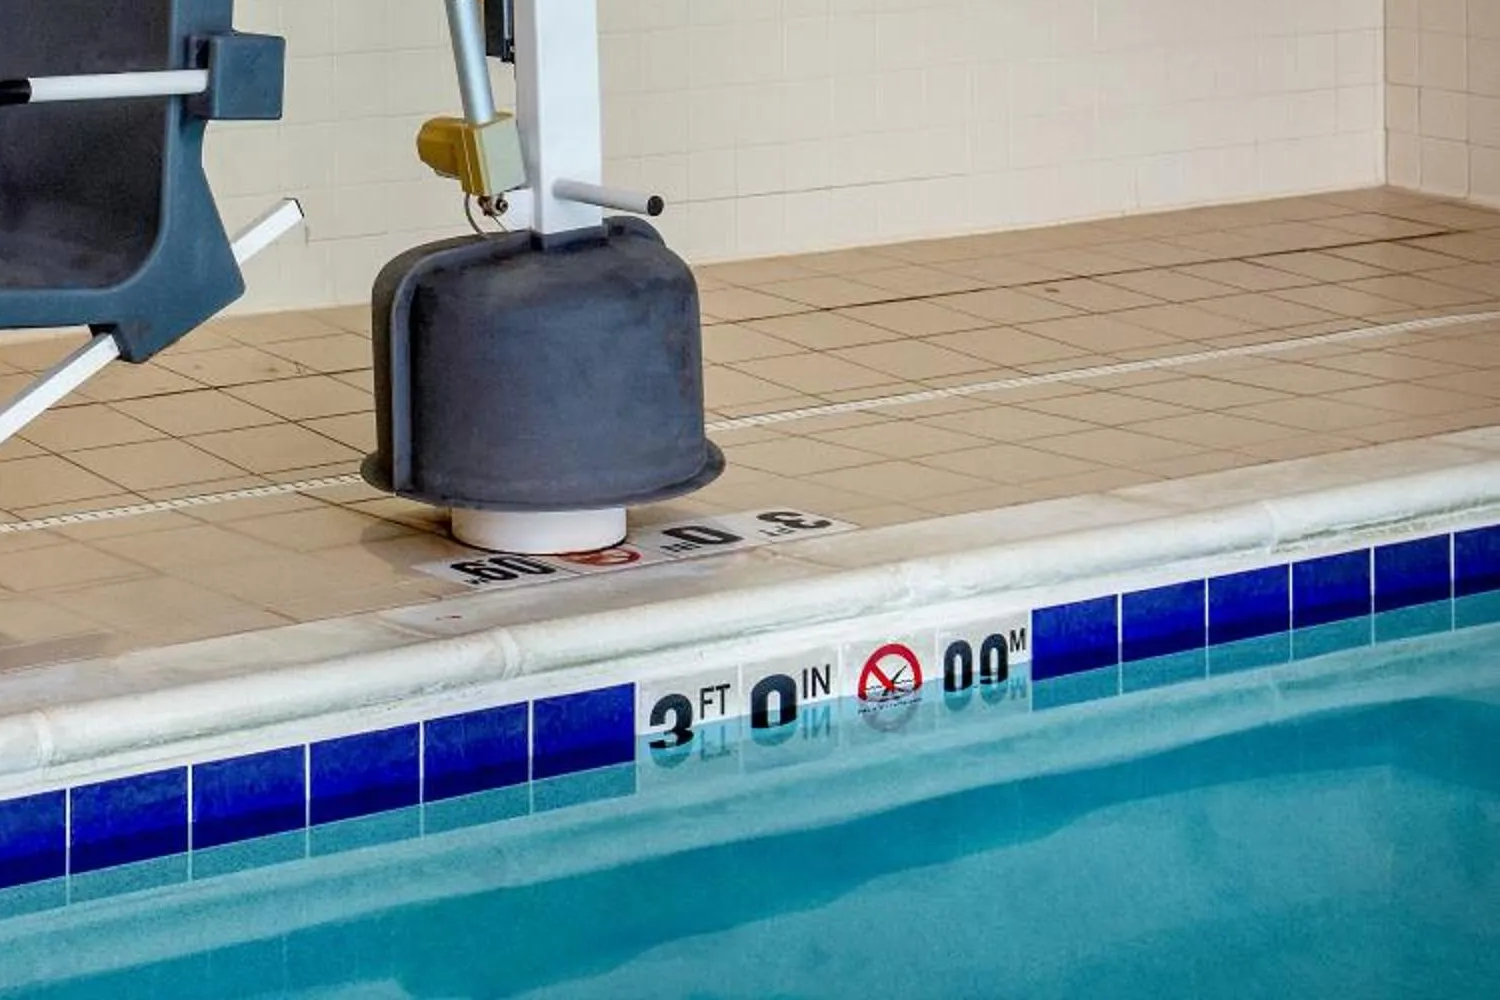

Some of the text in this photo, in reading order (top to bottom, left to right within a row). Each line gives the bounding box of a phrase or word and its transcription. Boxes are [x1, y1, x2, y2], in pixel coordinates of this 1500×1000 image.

[755, 510, 832, 530] 3
[662, 524, 745, 547] 0
[648, 693, 695, 749] 3
[700, 683, 732, 719] FT
[750, 673, 798, 729] 0
[801, 663, 832, 699] IN
[1009, 627, 1027, 653] M
